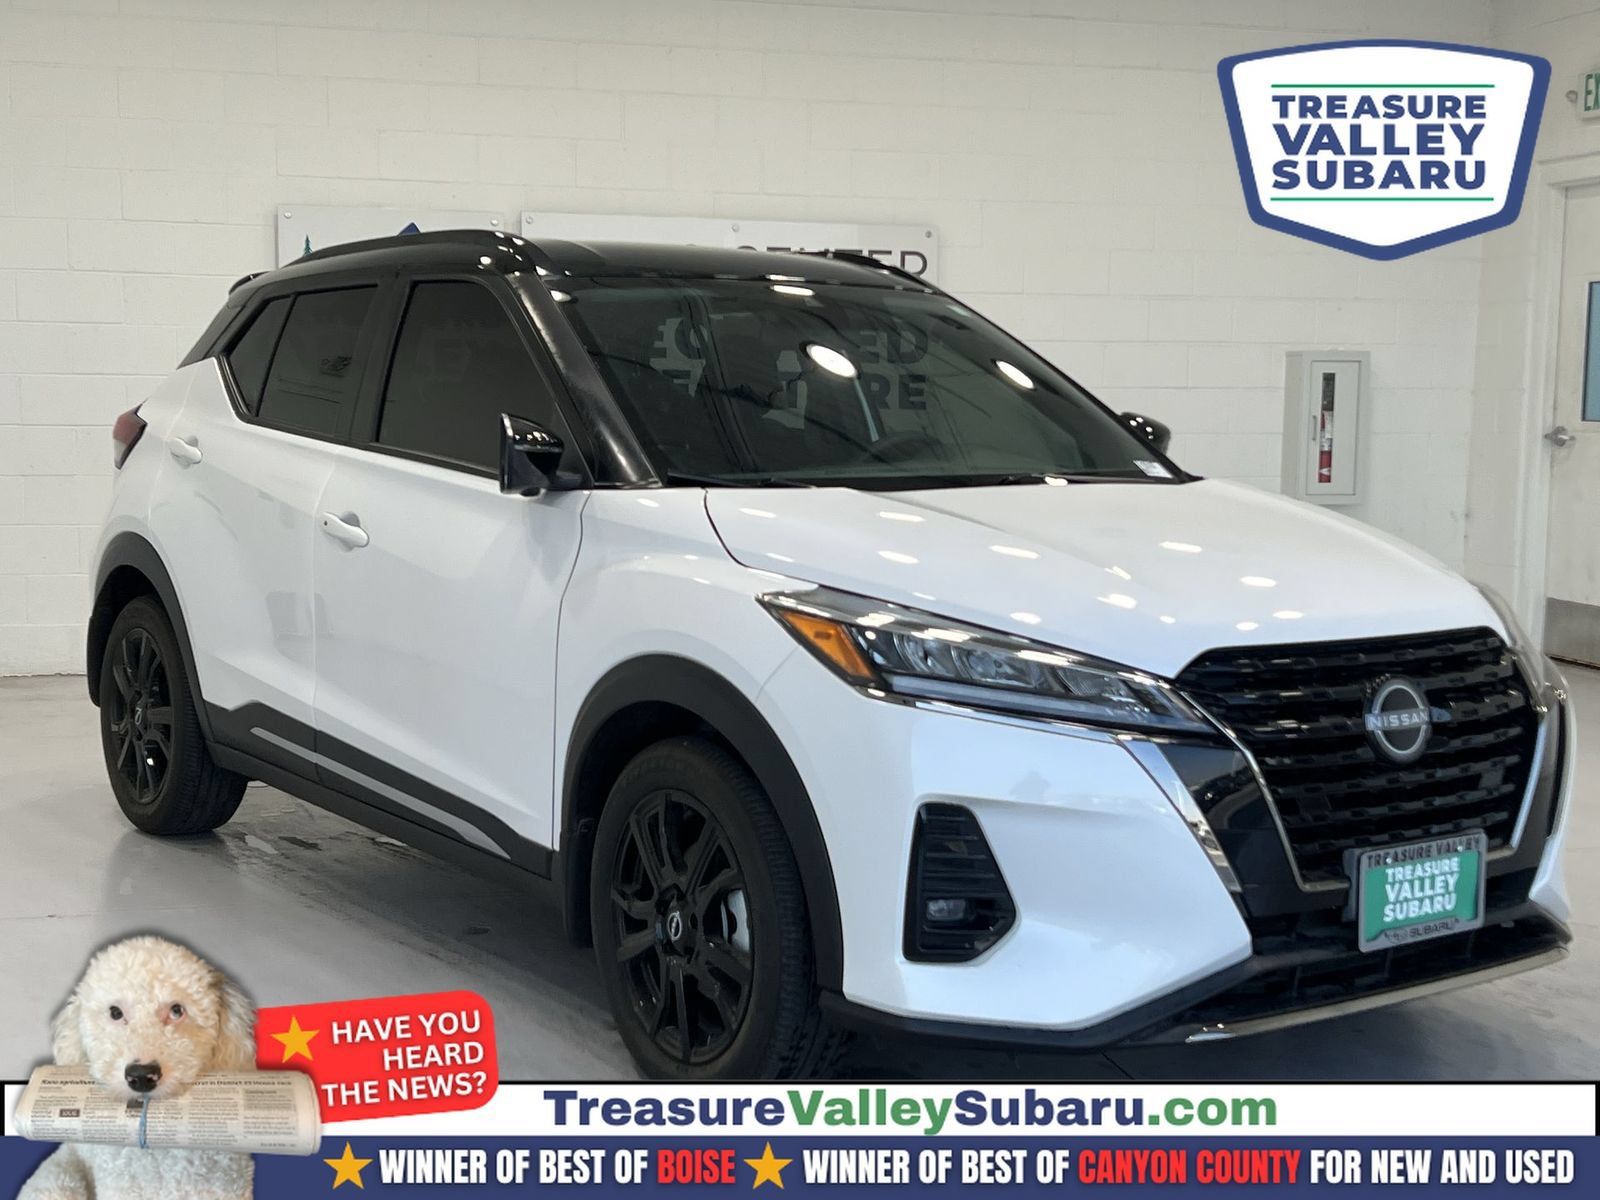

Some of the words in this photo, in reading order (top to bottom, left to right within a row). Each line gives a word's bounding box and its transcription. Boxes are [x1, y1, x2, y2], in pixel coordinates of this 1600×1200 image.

[1367, 711, 1429, 729] NISSAN
[1385, 857, 1461, 882] TREASURE
[1385, 873, 1460, 902] VALLEY
[1383, 893, 1457, 922] SUBARU
